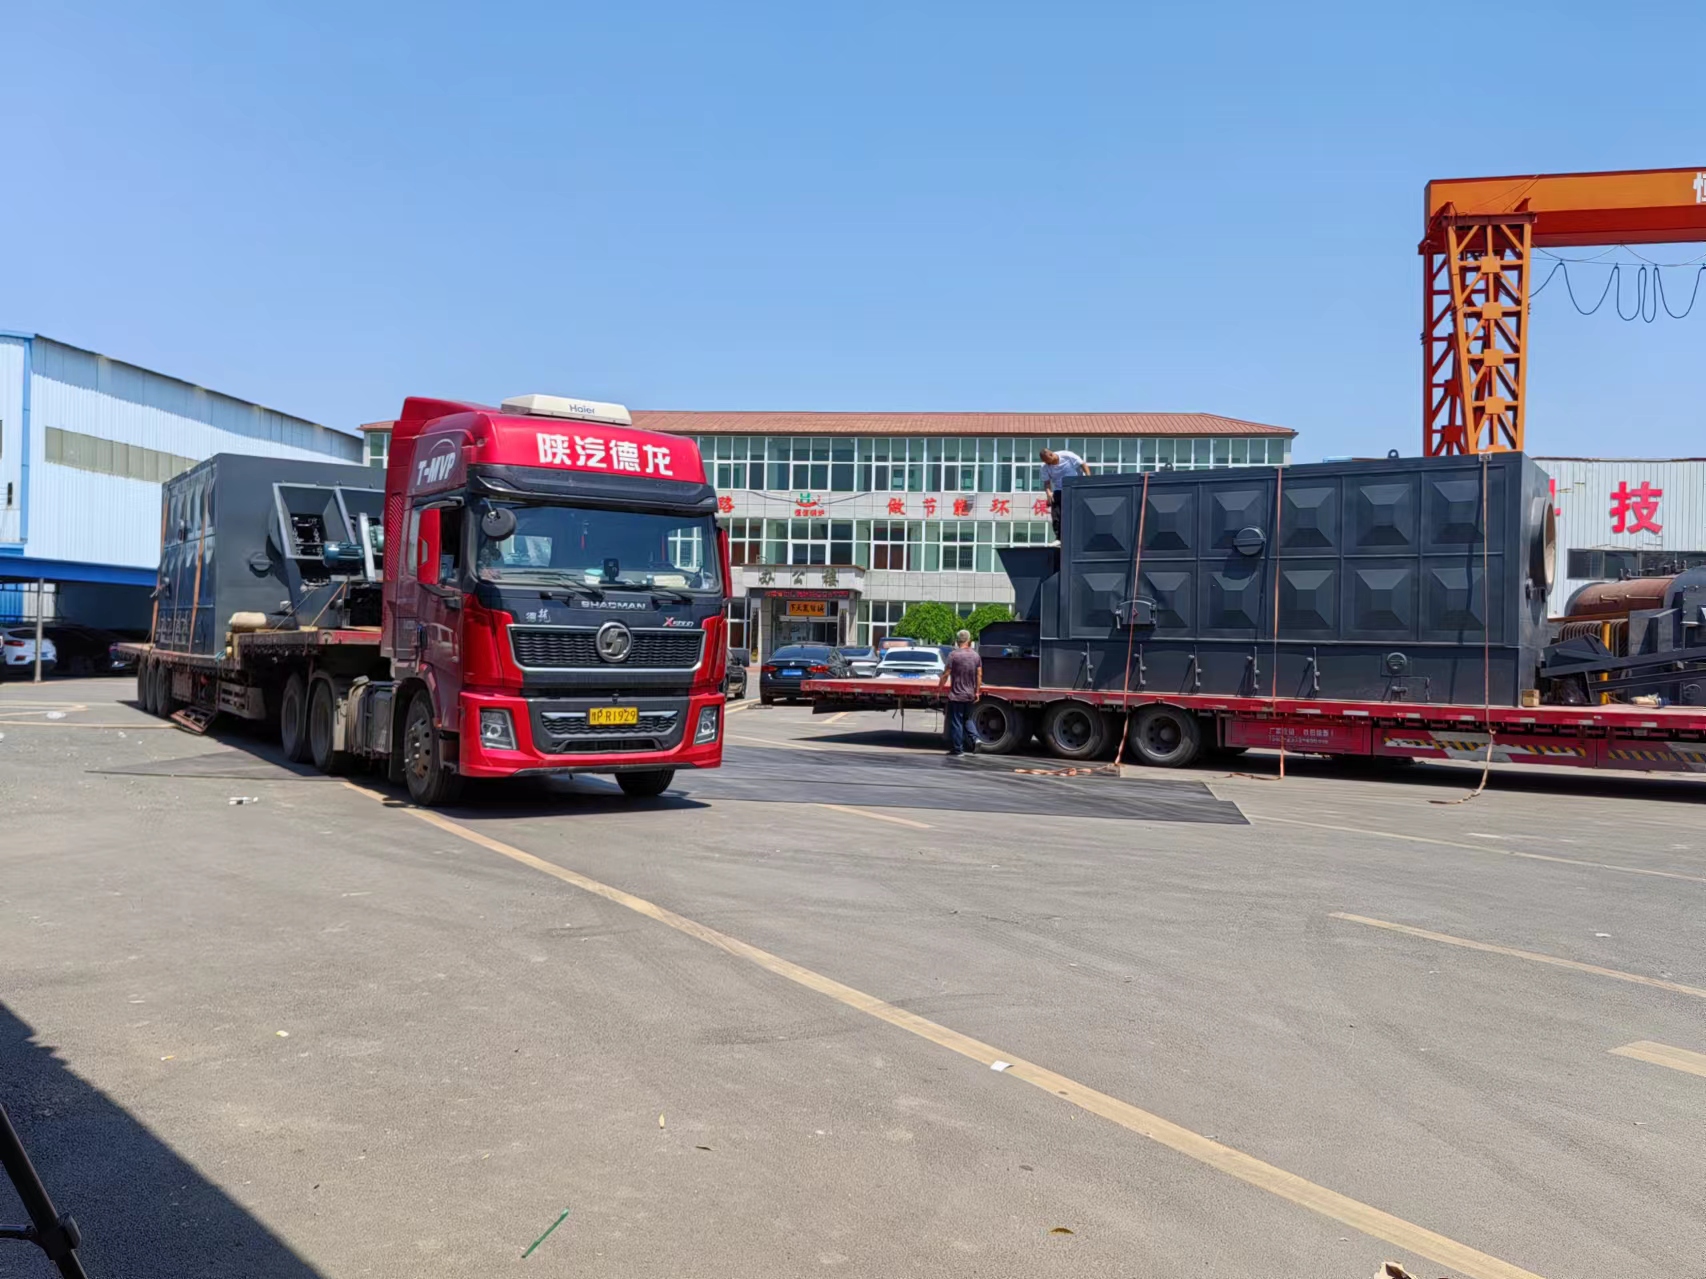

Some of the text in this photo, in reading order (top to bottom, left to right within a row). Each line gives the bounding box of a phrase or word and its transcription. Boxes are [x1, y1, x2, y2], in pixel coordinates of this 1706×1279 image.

[569, 404, 595, 415] Haier
[417, 452, 456, 485] T-MVP
[536, 432, 673, 476] 陕汽德龙
[1610, 481, 1663, 535] 技
